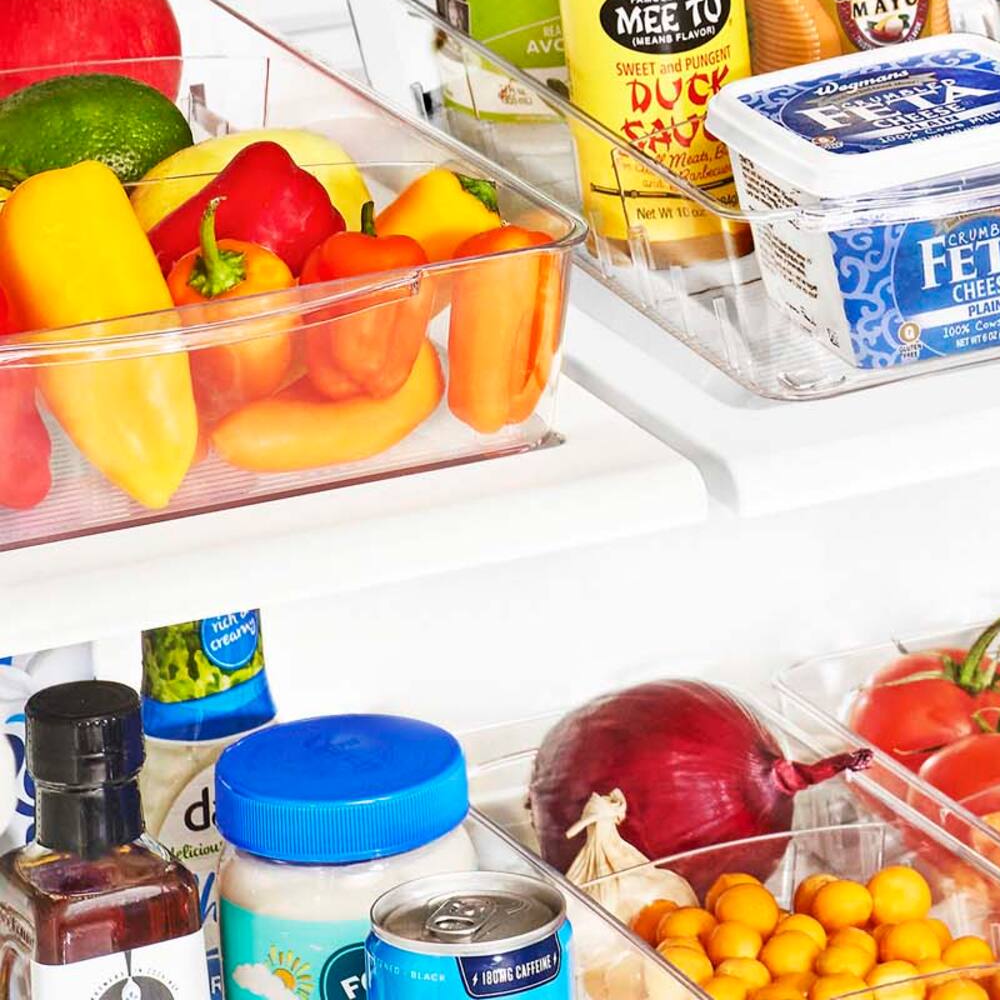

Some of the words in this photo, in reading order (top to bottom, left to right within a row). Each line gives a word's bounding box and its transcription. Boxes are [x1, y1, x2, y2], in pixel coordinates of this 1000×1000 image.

[615, 2, 680, 36] MEE
[631, 34, 674, 47] (MEANS
[675, 26, 716, 43] FLAVOR)
[616, 61, 656, 77] SWEET
[660, 58, 683, 74] and
[686, 45, 732, 71] PUNGENT
[626, 64, 730, 113] DUCK
[814, 69, 910, 97] Wegmans
[841, 78, 957, 109] CRUMBLED
[797, 84, 1000, 131] FETA
[872, 101, 966, 129] CHEESE
[878, 131, 919, 143] 100%
[902, 115, 962, 132] PLAIN
[636, 207, 656, 220] Net
[660, 207, 673, 219] Wt
[943, 324, 970, 339] 100%
[956, 337, 969, 348] NET
[970, 336, 981, 345] WT
[989, 332, 999, 342] OZ
[209, 618, 256, 652] creamy
[410, 971, 446, 982] BLACK
[482, 968, 514, 985] 180MG
[515, 958, 553, 979] CAFFEINE
